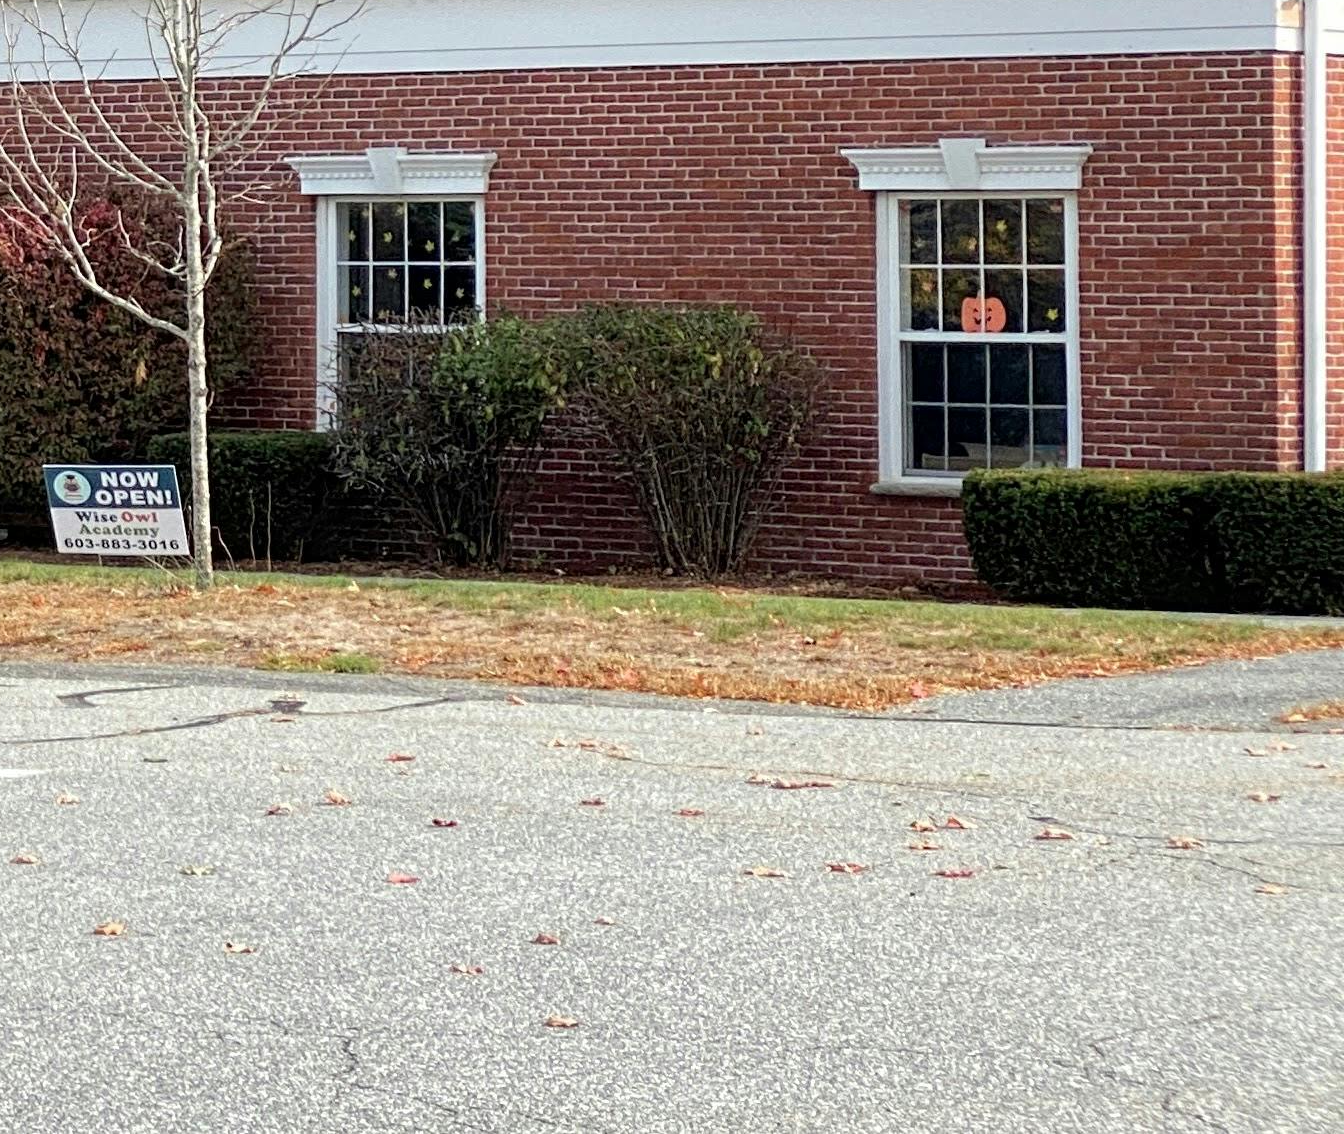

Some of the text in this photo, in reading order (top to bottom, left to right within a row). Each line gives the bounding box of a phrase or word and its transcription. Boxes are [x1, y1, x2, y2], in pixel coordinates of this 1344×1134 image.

[100, 471, 159, 487] NOW
[94, 489, 173, 505] OPEN!
[75, 511, 159, 523] Wise Owl
[79, 524, 160, 538] Academy
[64, 537, 180, 550] 603-883-3016
